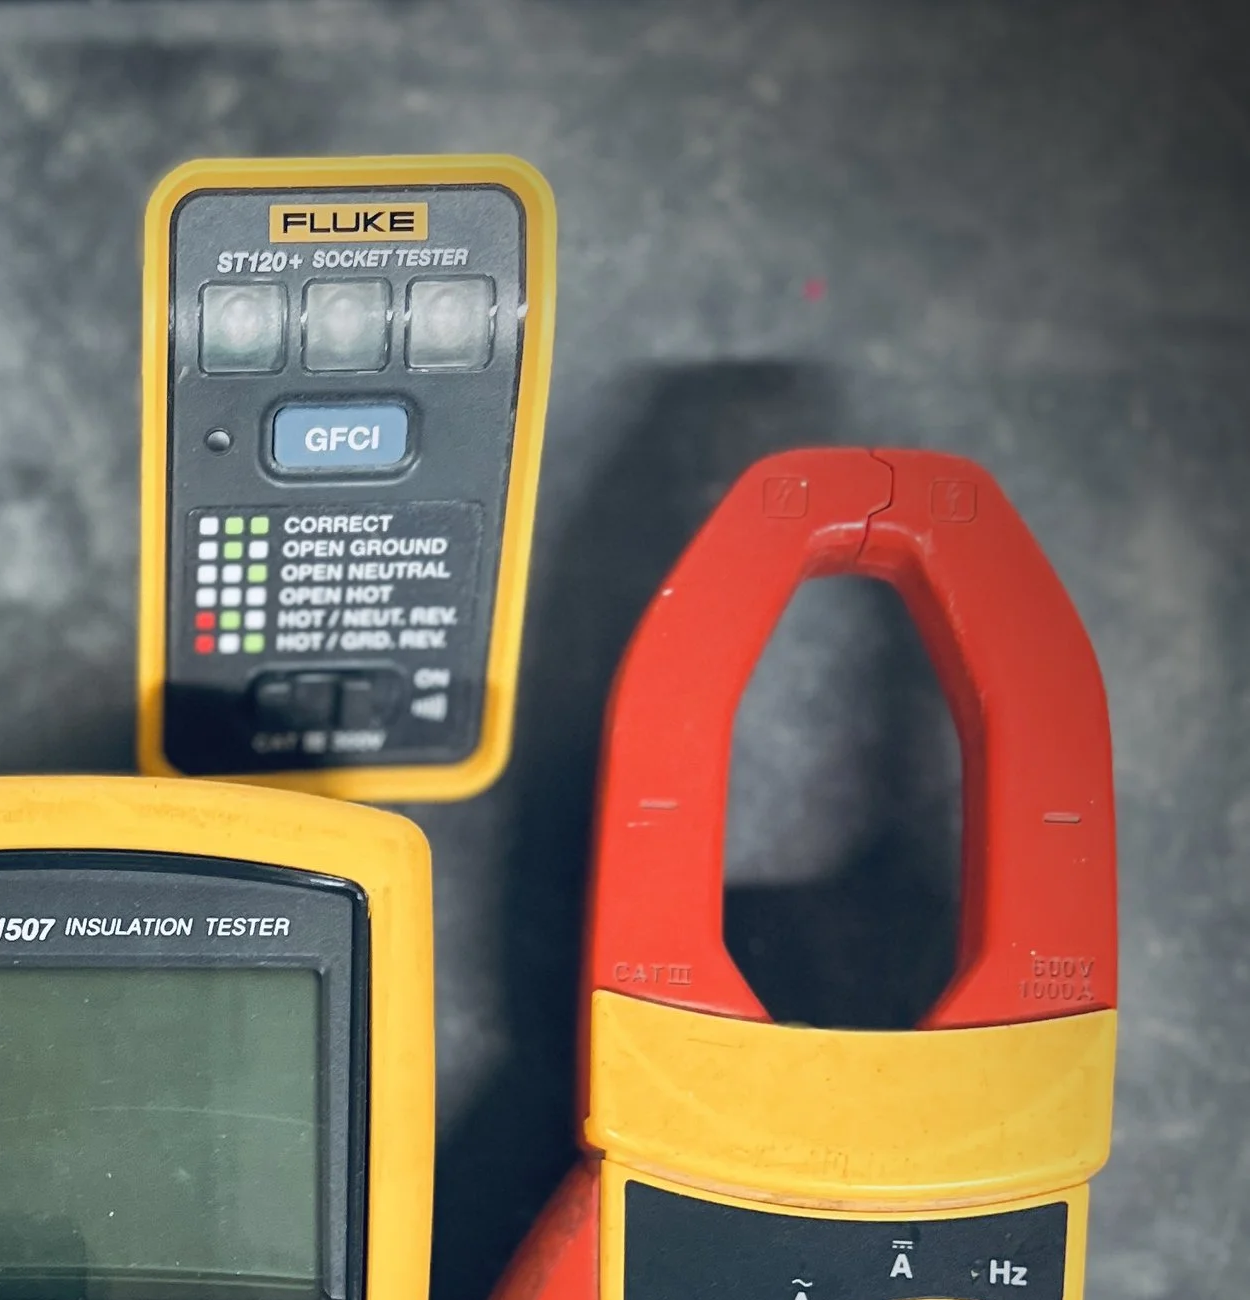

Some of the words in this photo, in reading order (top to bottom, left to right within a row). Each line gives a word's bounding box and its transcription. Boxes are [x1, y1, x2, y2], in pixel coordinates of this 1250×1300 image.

[282, 210, 415, 234] FLUKE
[217, 251, 302, 274] ST120+
[312, 250, 395, 269] SOCKET
[397, 248, 469, 267] TESTER
[305, 425, 380, 451] GFCI
[283, 514, 393, 534] CORRECT
[282, 540, 344, 558] OPEN
[350, 538, 447, 556] GROUND
[281, 564, 343, 582] OPEN
[347, 561, 451, 581] NEUTRAL
[279, 587, 340, 606] OPEN
[346, 585, 393, 603] HOT
[277, 610, 324, 629] HOT
[410, 607, 457, 626] REV.
[276, 633, 323, 652] HOT
[399, 630, 445, 650] REV.
[65, 917, 192, 936] INSULATION
[205, 917, 290, 936] TESTER
[614, 963, 665, 983] CAT
[990, 1260, 1028, 1286] Hz
